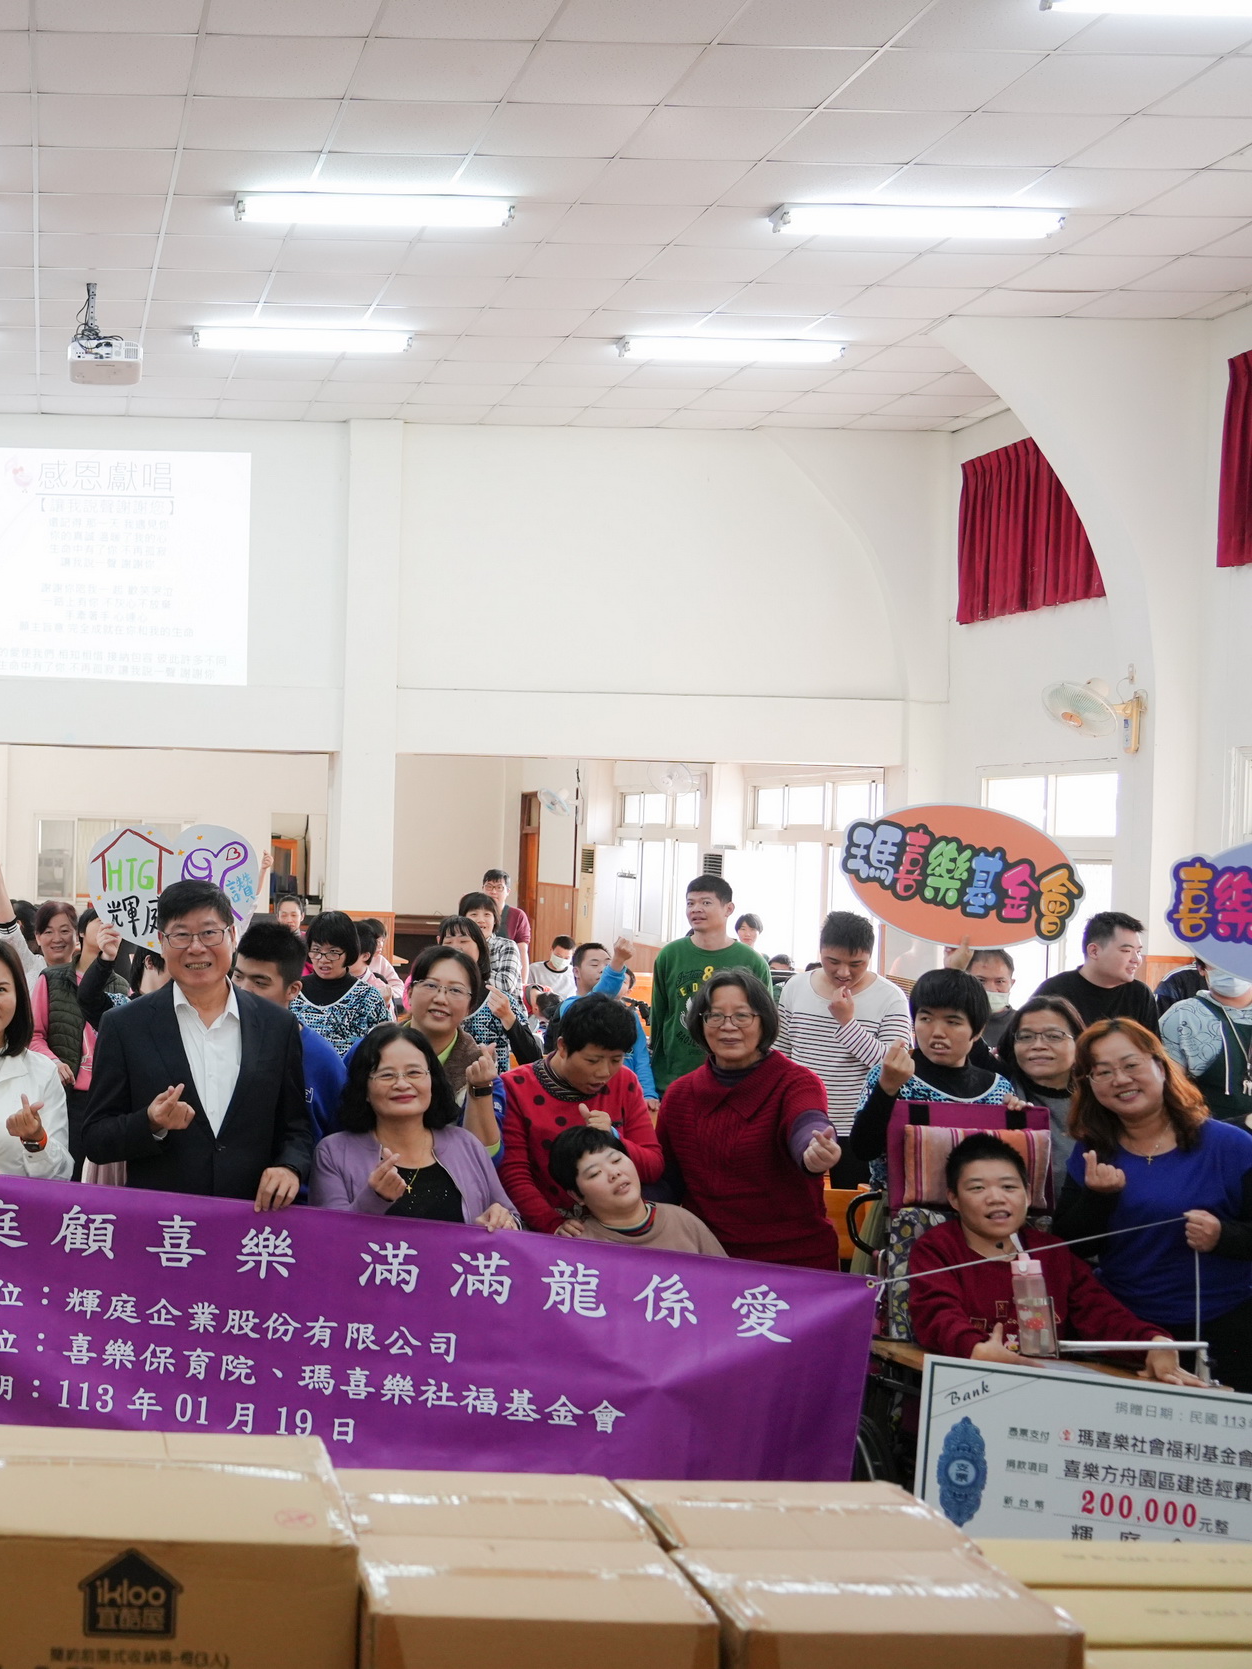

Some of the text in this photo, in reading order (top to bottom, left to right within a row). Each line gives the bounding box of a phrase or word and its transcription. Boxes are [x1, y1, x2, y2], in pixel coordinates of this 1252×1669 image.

[38, 459, 172, 492] 感恩獻唱
[107, 858, 154, 892] HTG
[225, 872, 255, 903] 讚
[847, 824, 1080, 937] 瑪喜樂基金會
[358, 1240, 792, 1344] 滿滿龍係愛
[944, 1381, 991, 1406] Bank
[126, 1387, 164, 1422] 年
[175, 1392, 209, 1427] 01
[225, 1402, 256, 1435] 月
[276, 1406, 313, 1439] 19
[332, 1416, 356, 1444] 日
[1077, 1428, 1252, 1468] 瑪喜樂社會福利基金會
[1006, 1459, 1048, 1474] 捐款項目
[1063, 1459, 1252, 1502] 喜樂方舟園區建造經費
[1081, 1489, 1197, 1528] 200,000
[96, 1578, 165, 1606] ikloo
